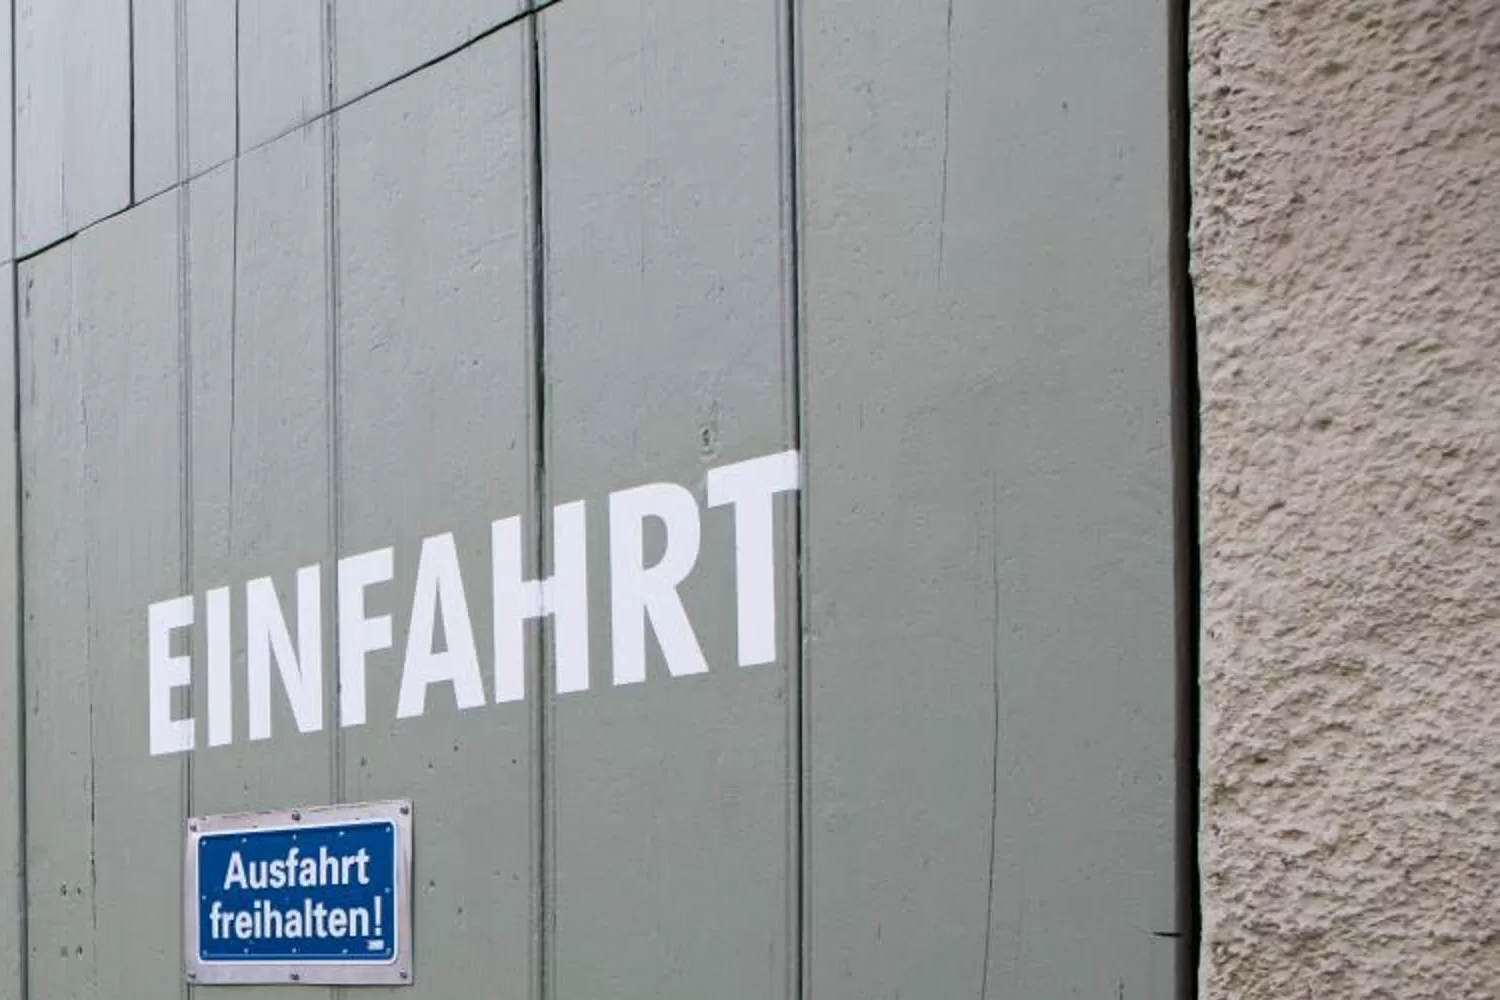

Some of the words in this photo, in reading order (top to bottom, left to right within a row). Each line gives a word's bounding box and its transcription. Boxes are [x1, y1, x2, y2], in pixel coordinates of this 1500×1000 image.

[147, 448, 801, 757] EINFAHRT
[222, 845, 371, 890] Ausfahrt
[209, 895, 383, 939] freihalten!
